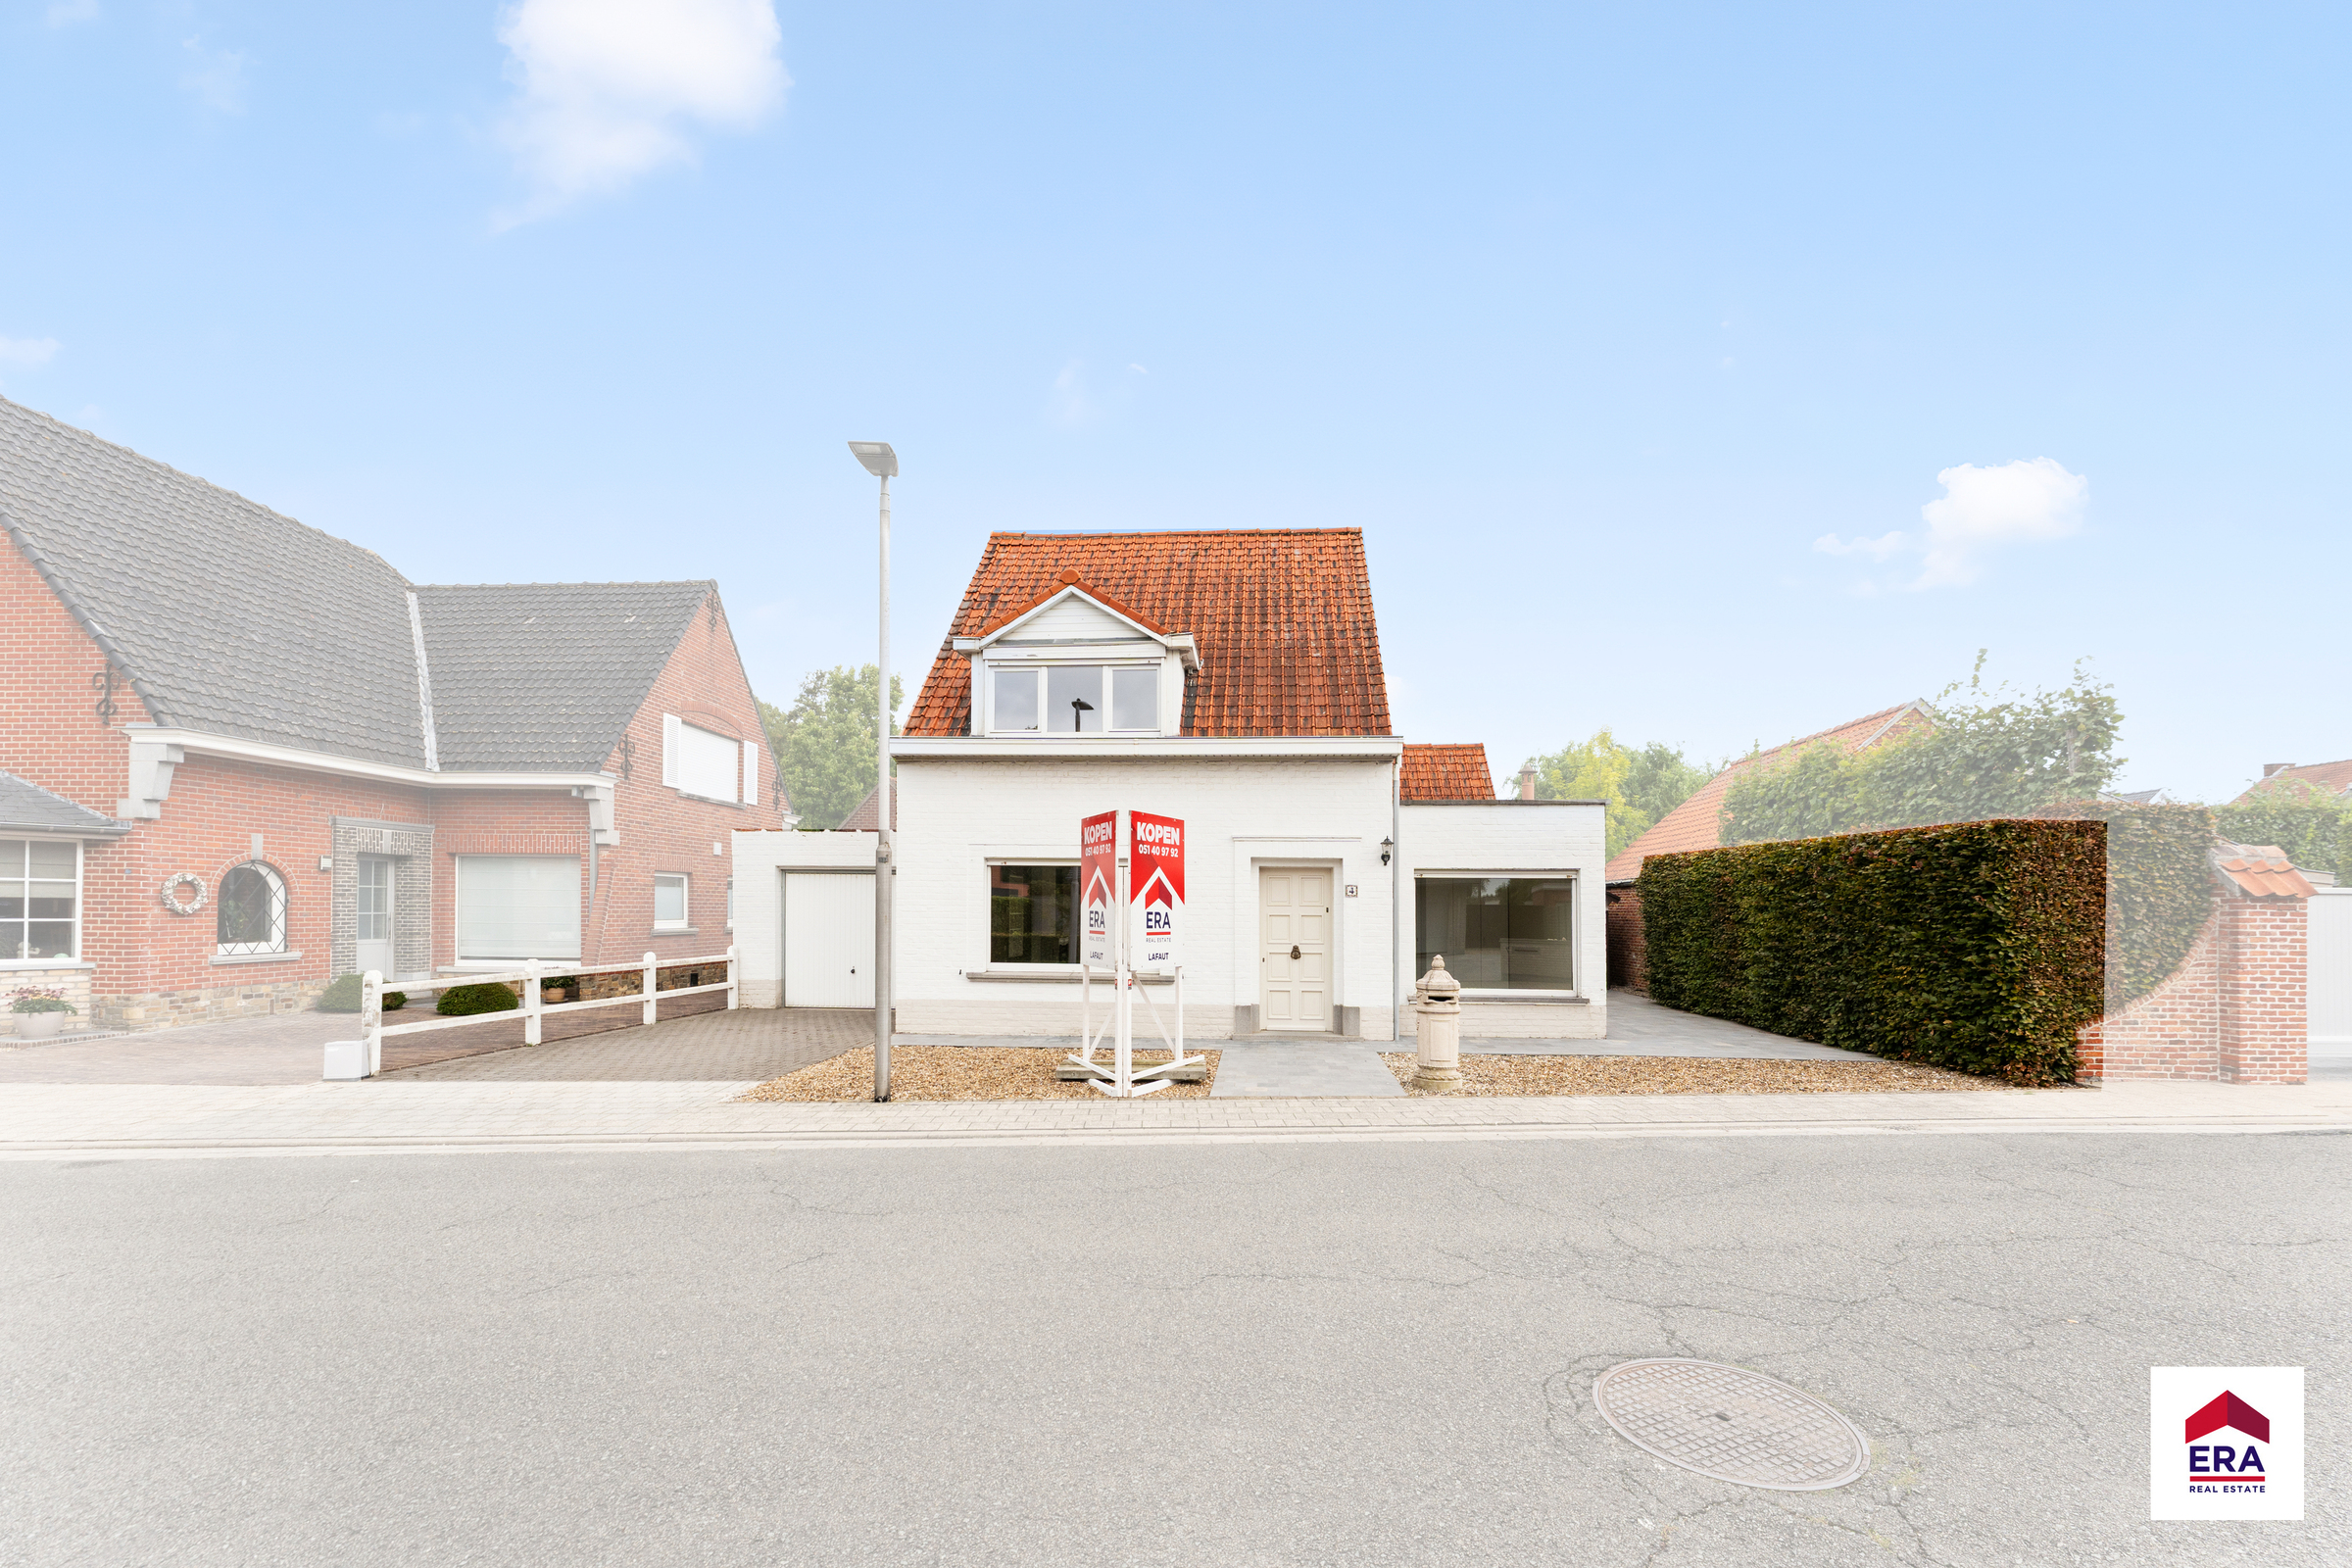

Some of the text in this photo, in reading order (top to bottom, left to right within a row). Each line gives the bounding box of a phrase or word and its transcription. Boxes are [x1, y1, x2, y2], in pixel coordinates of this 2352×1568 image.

[1084, 821, 1112, 845] KOPEN
[1137, 821, 1180, 846] KOPEN
[1093, 845, 1099, 856] 40
[1100, 844, 1105, 855] 97
[1105, 843, 1111, 854] 92
[1139, 844, 1179, 858] 051 40 97 92
[1089, 910, 1105, 928] ERA
[1146, 911, 1171, 929] ERA
[1090, 951, 1103, 960] LAFAUT
